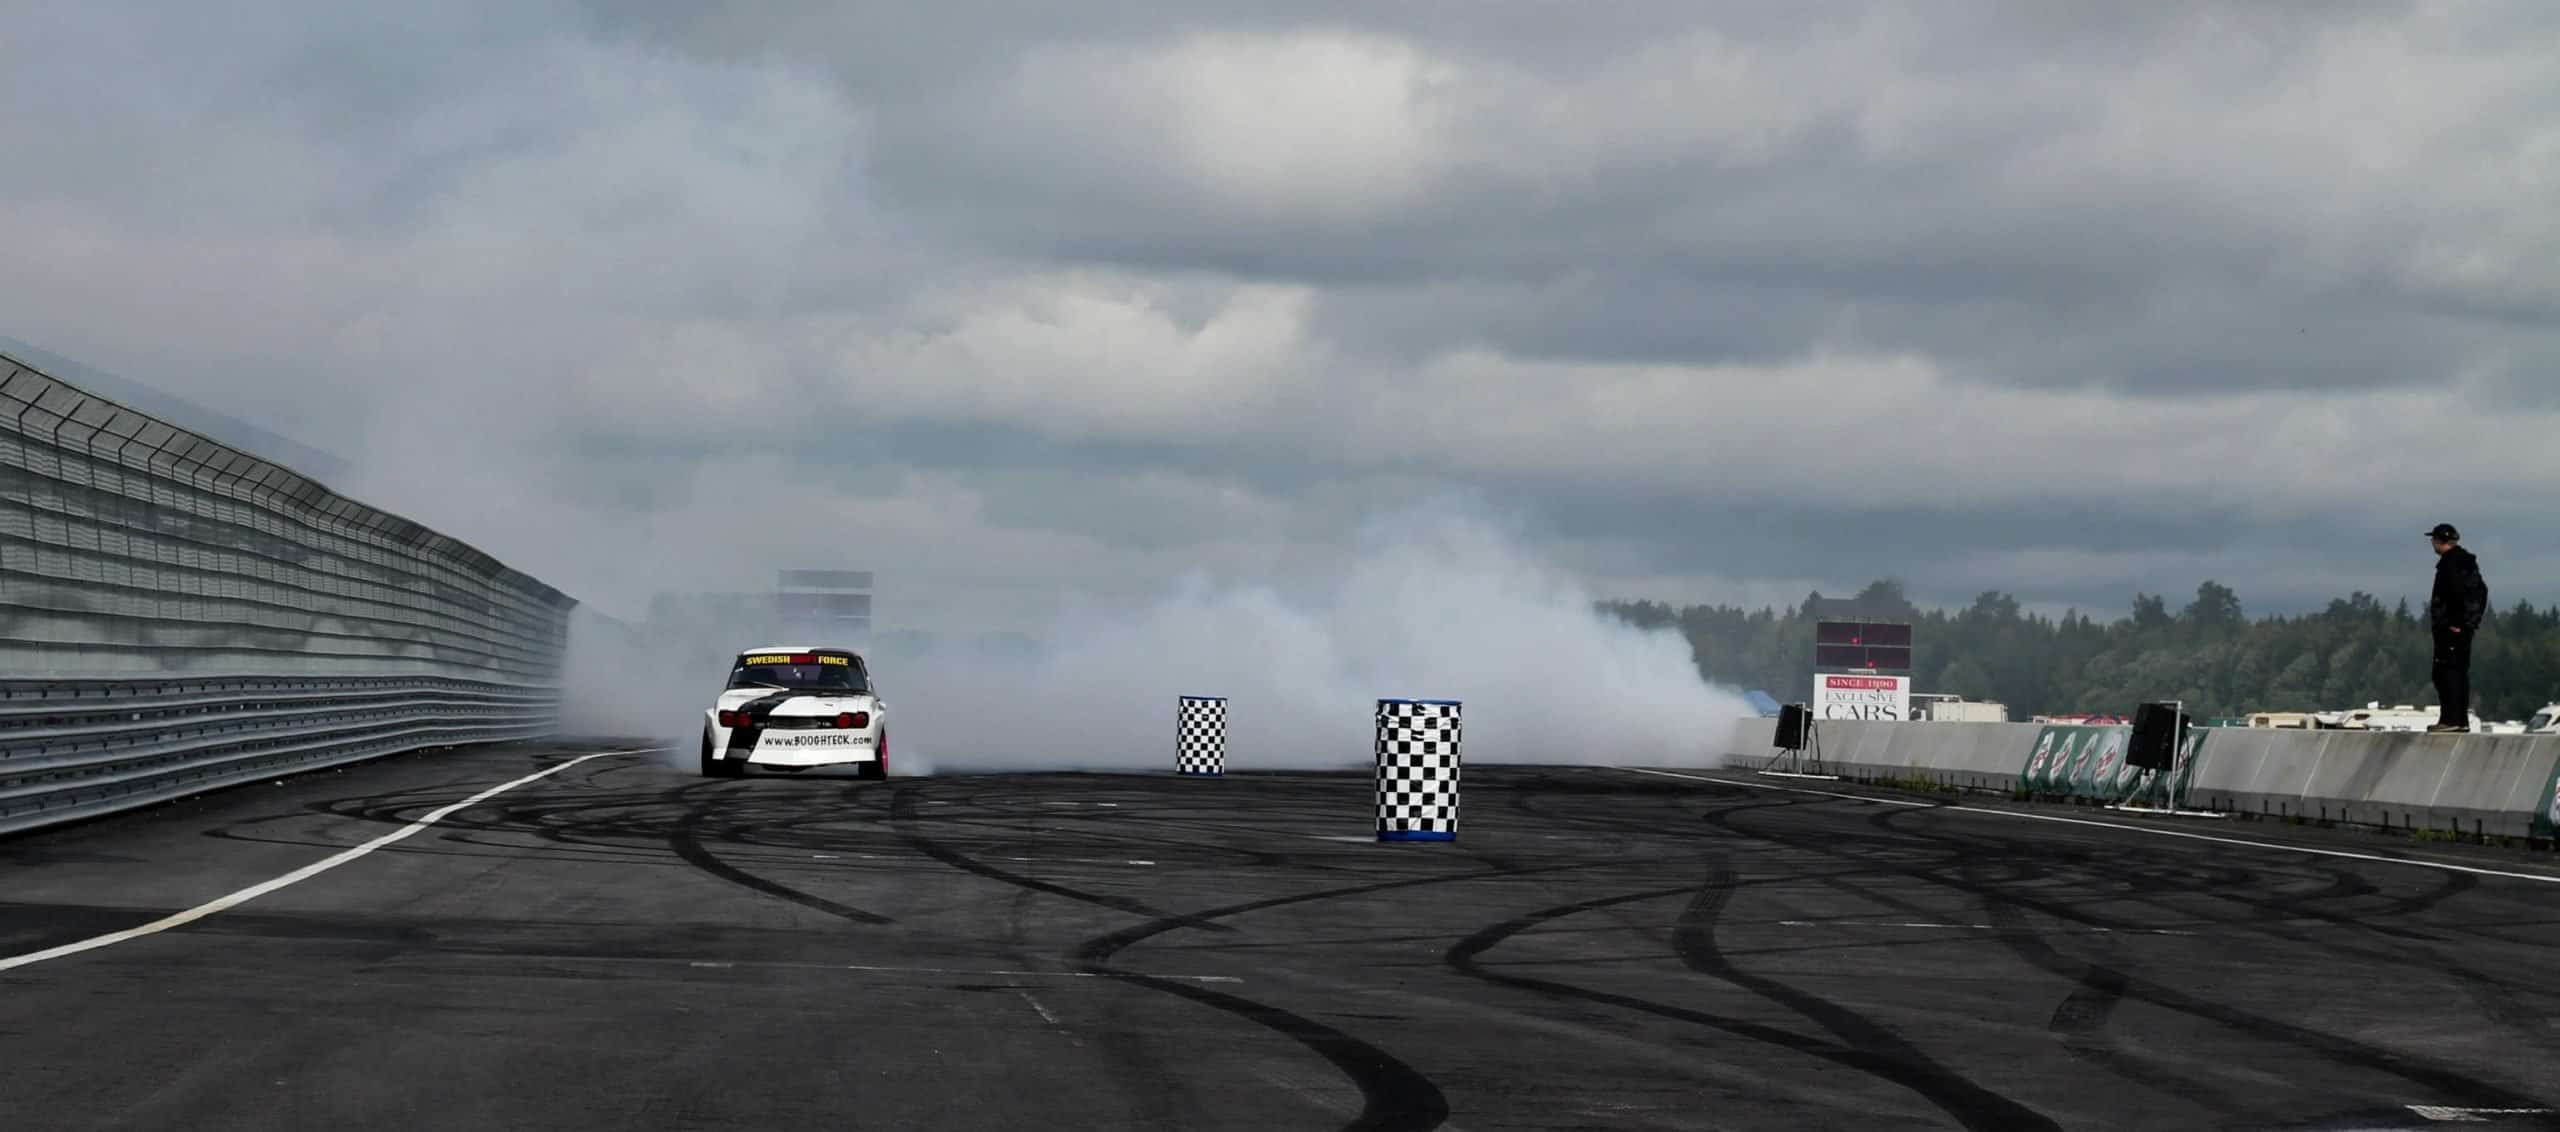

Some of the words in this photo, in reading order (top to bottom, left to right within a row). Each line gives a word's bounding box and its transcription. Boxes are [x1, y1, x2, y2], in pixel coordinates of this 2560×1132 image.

[746, 655, 791, 665] SWEDISH
[818, 656, 848, 665] FORCE
[1829, 679, 1863, 688] SINCE
[1826, 692, 1896, 701] EXCLUSIVE
[1826, 704, 1896, 720] CARS
